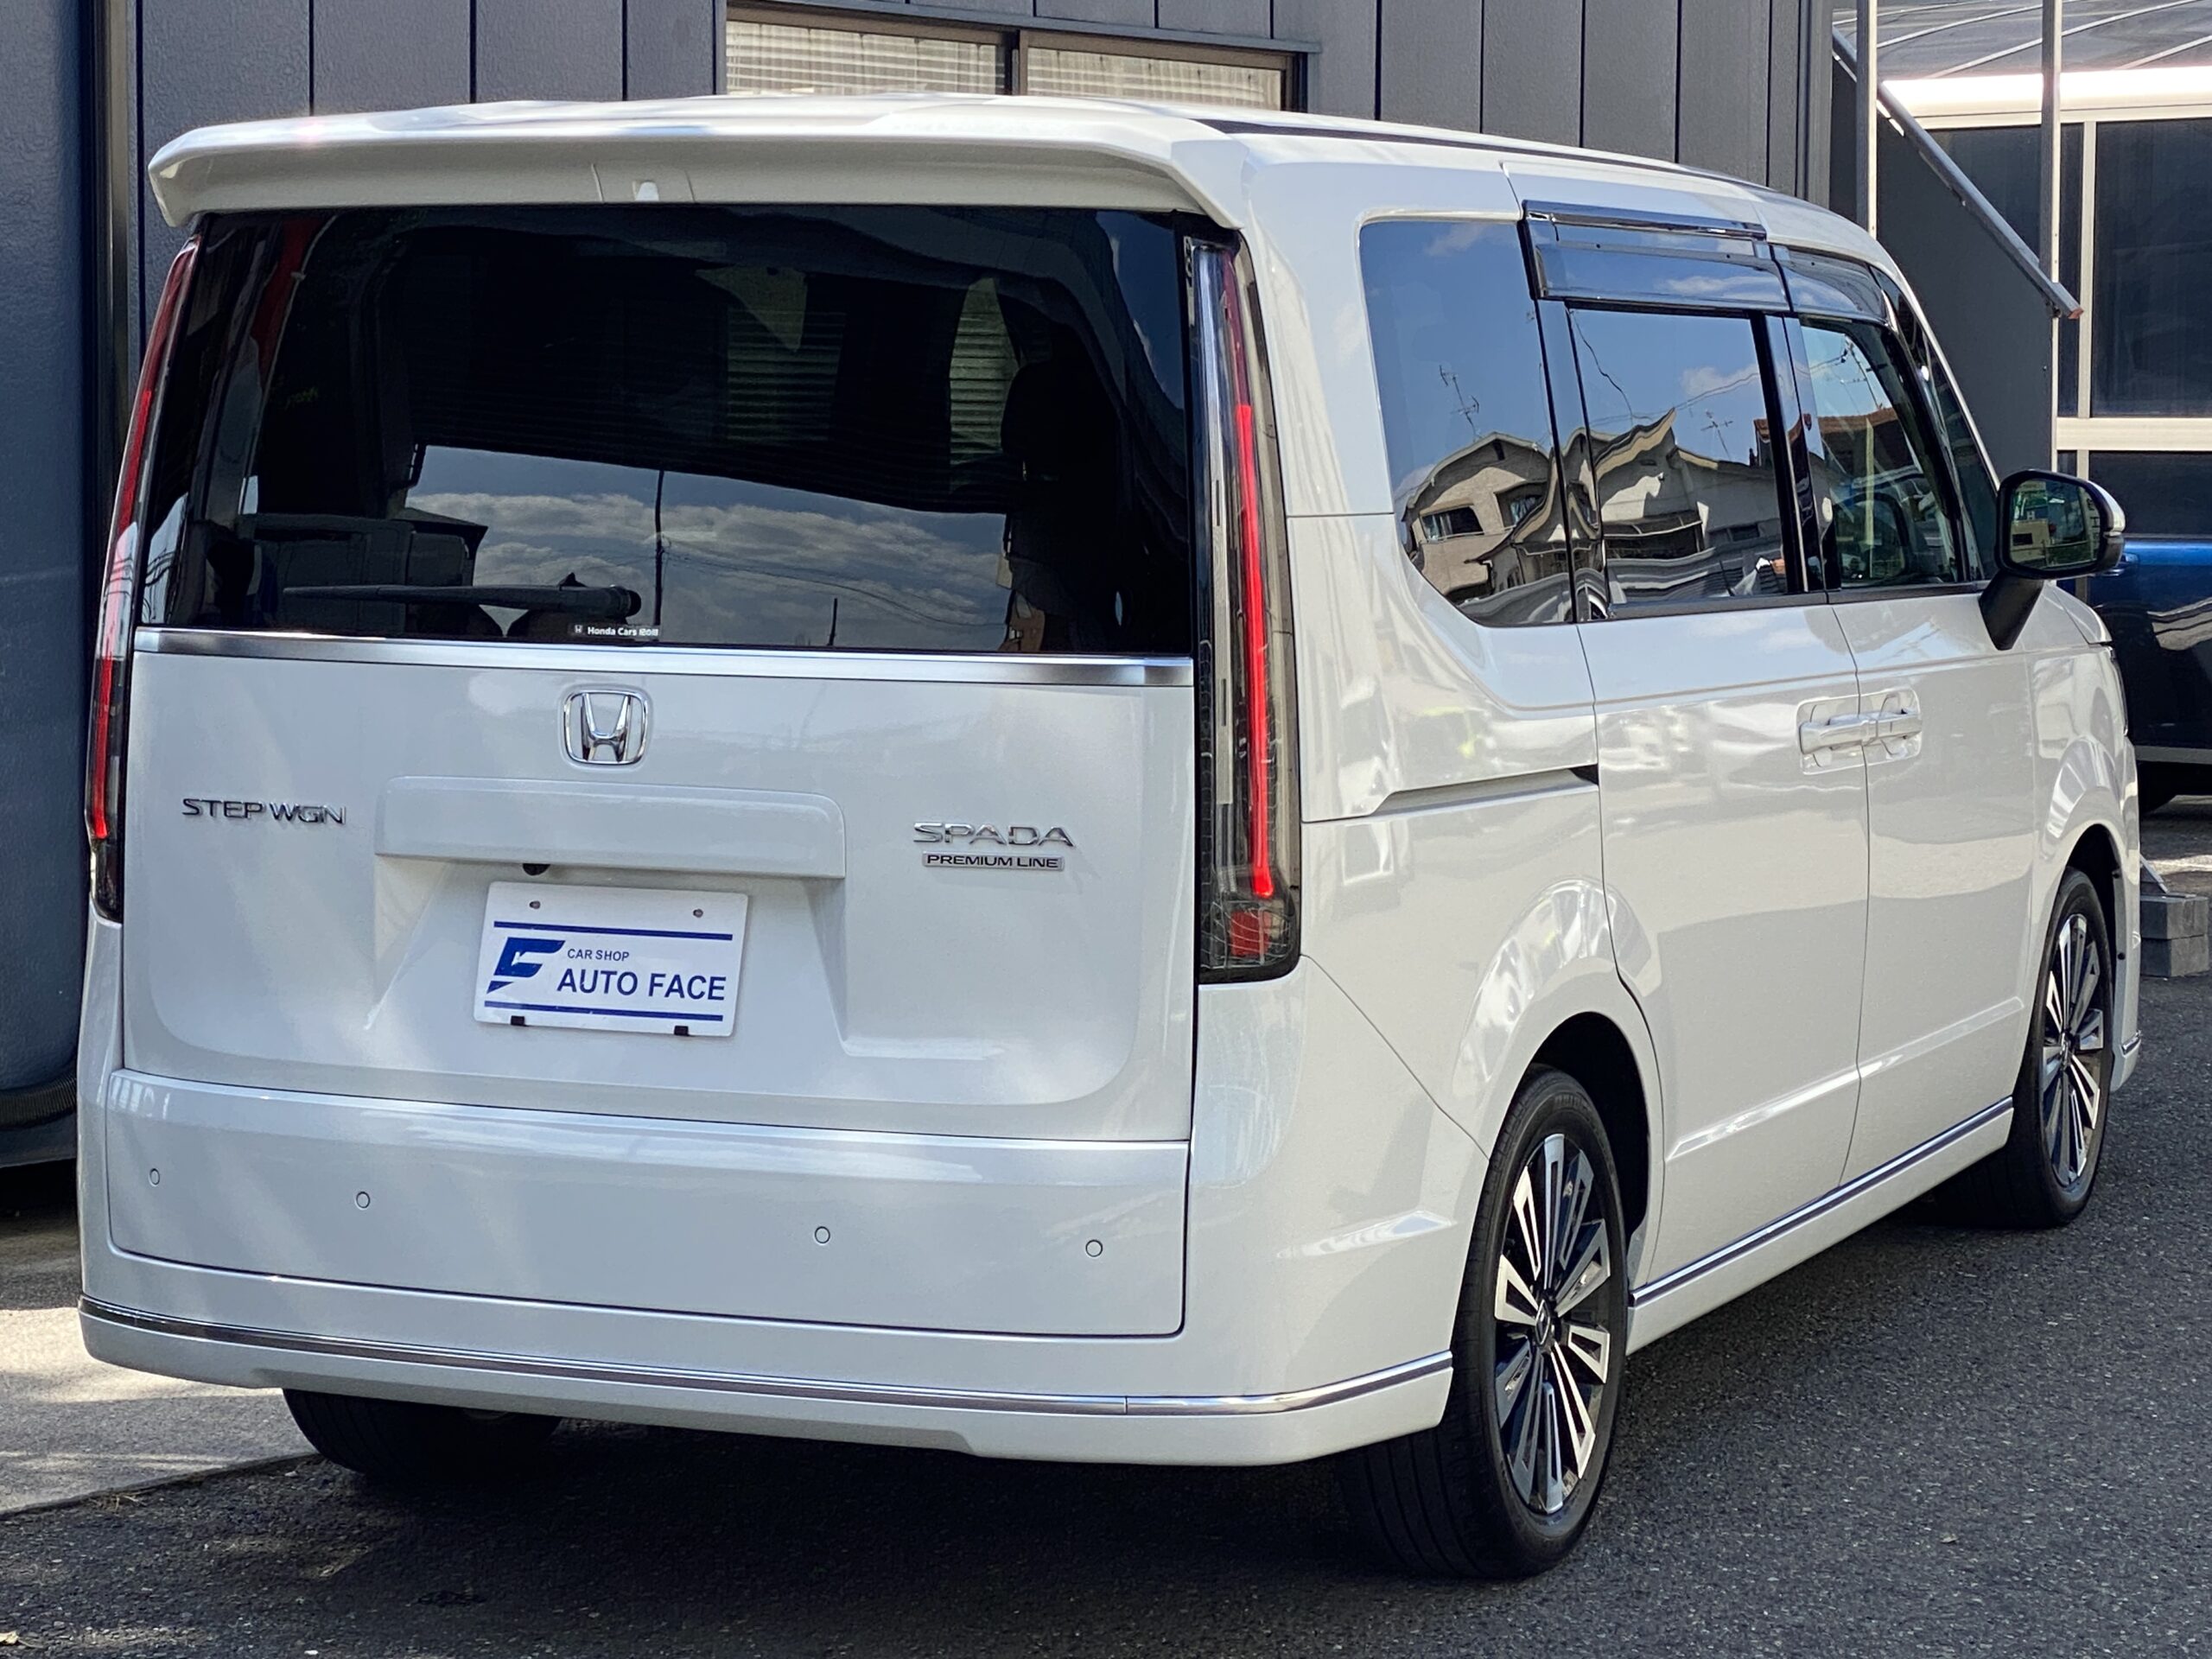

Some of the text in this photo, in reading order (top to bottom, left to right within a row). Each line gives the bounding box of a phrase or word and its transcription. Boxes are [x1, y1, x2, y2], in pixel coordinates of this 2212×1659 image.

[587, 626, 616, 635] Honda
[618, 627, 638, 636] Cars
[913, 823, 1076, 848] SPADA
[926, 854, 1059, 868] PREMIUM LINE
[567, 949, 630, 962] CAR SHOP
[556, 969, 727, 1001] AUTO FACE
